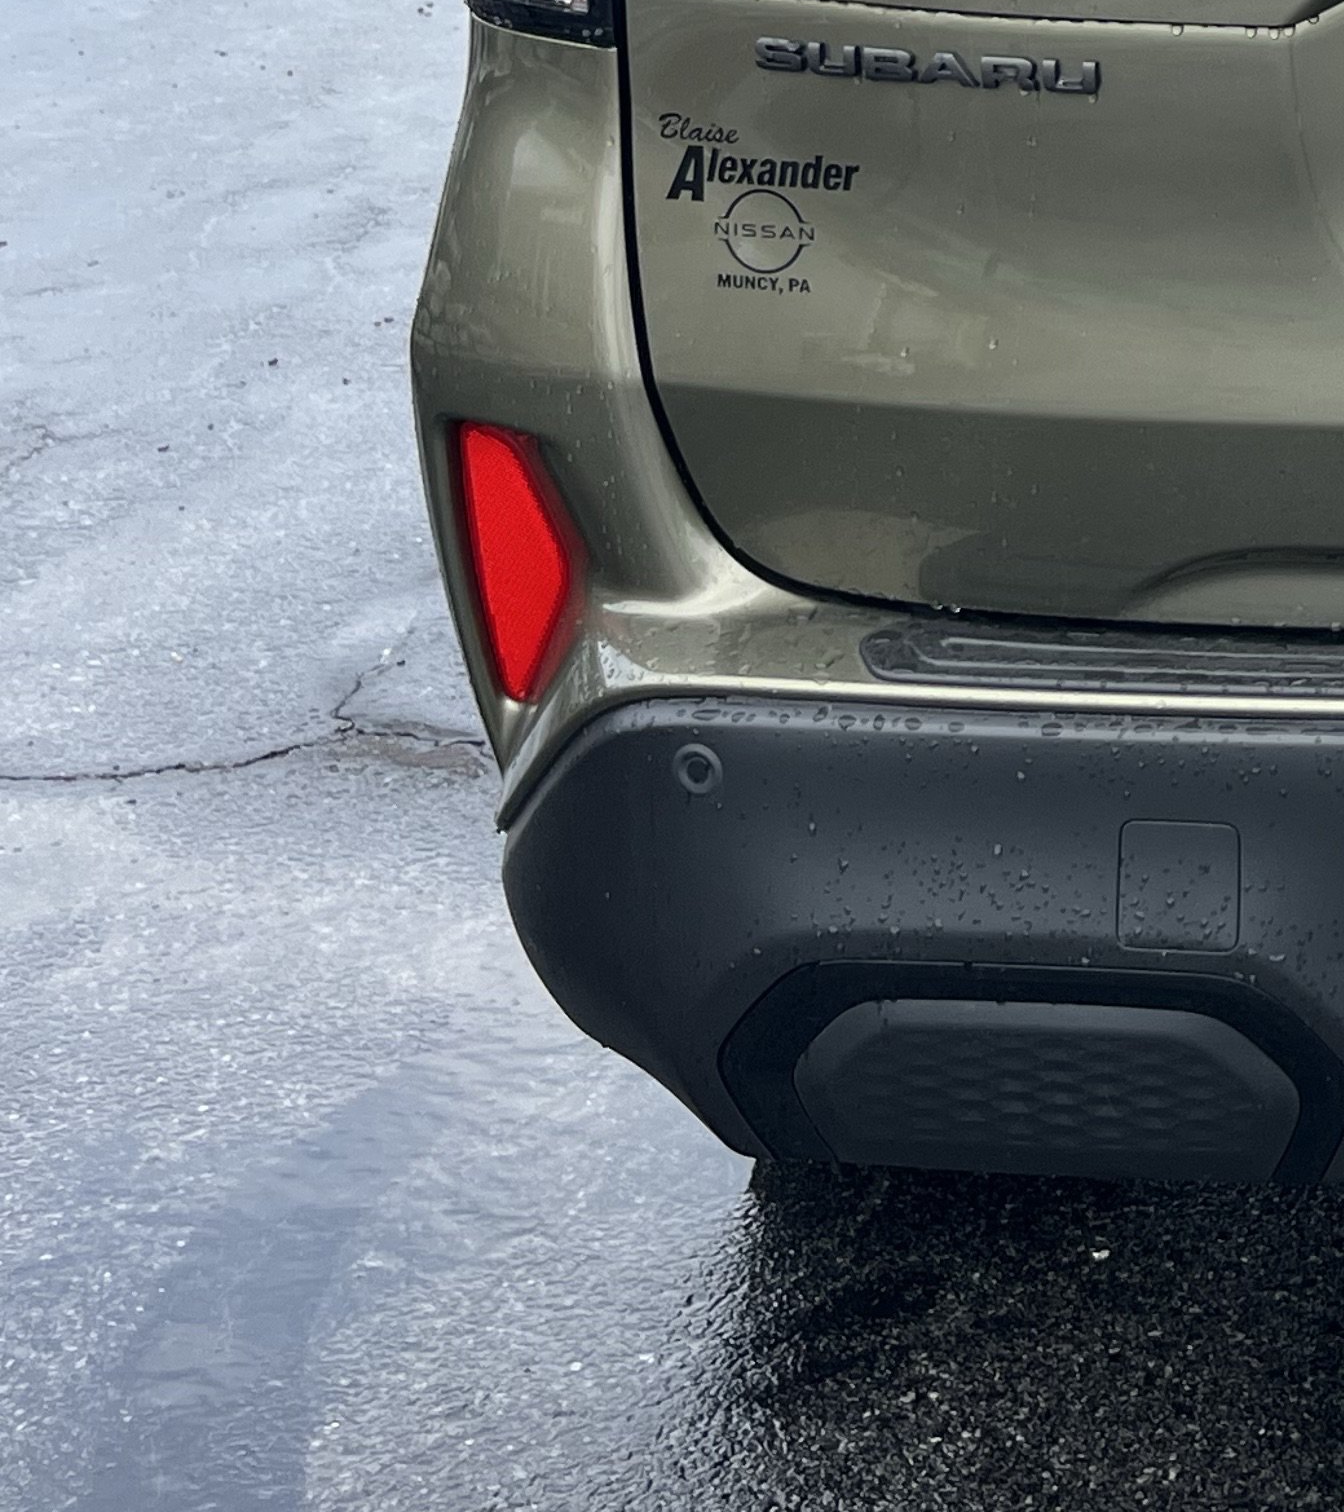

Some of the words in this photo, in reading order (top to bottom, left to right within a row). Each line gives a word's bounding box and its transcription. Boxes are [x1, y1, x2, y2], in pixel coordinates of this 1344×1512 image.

[754, 36, 1102, 95] SUBARU
[658, 112, 740, 144] Blaise
[665, 144, 860, 202] Alexander
[713, 221, 815, 241] NISSAN
[717, 273, 784, 295] MUNCY,
[788, 277, 812, 294] PA
